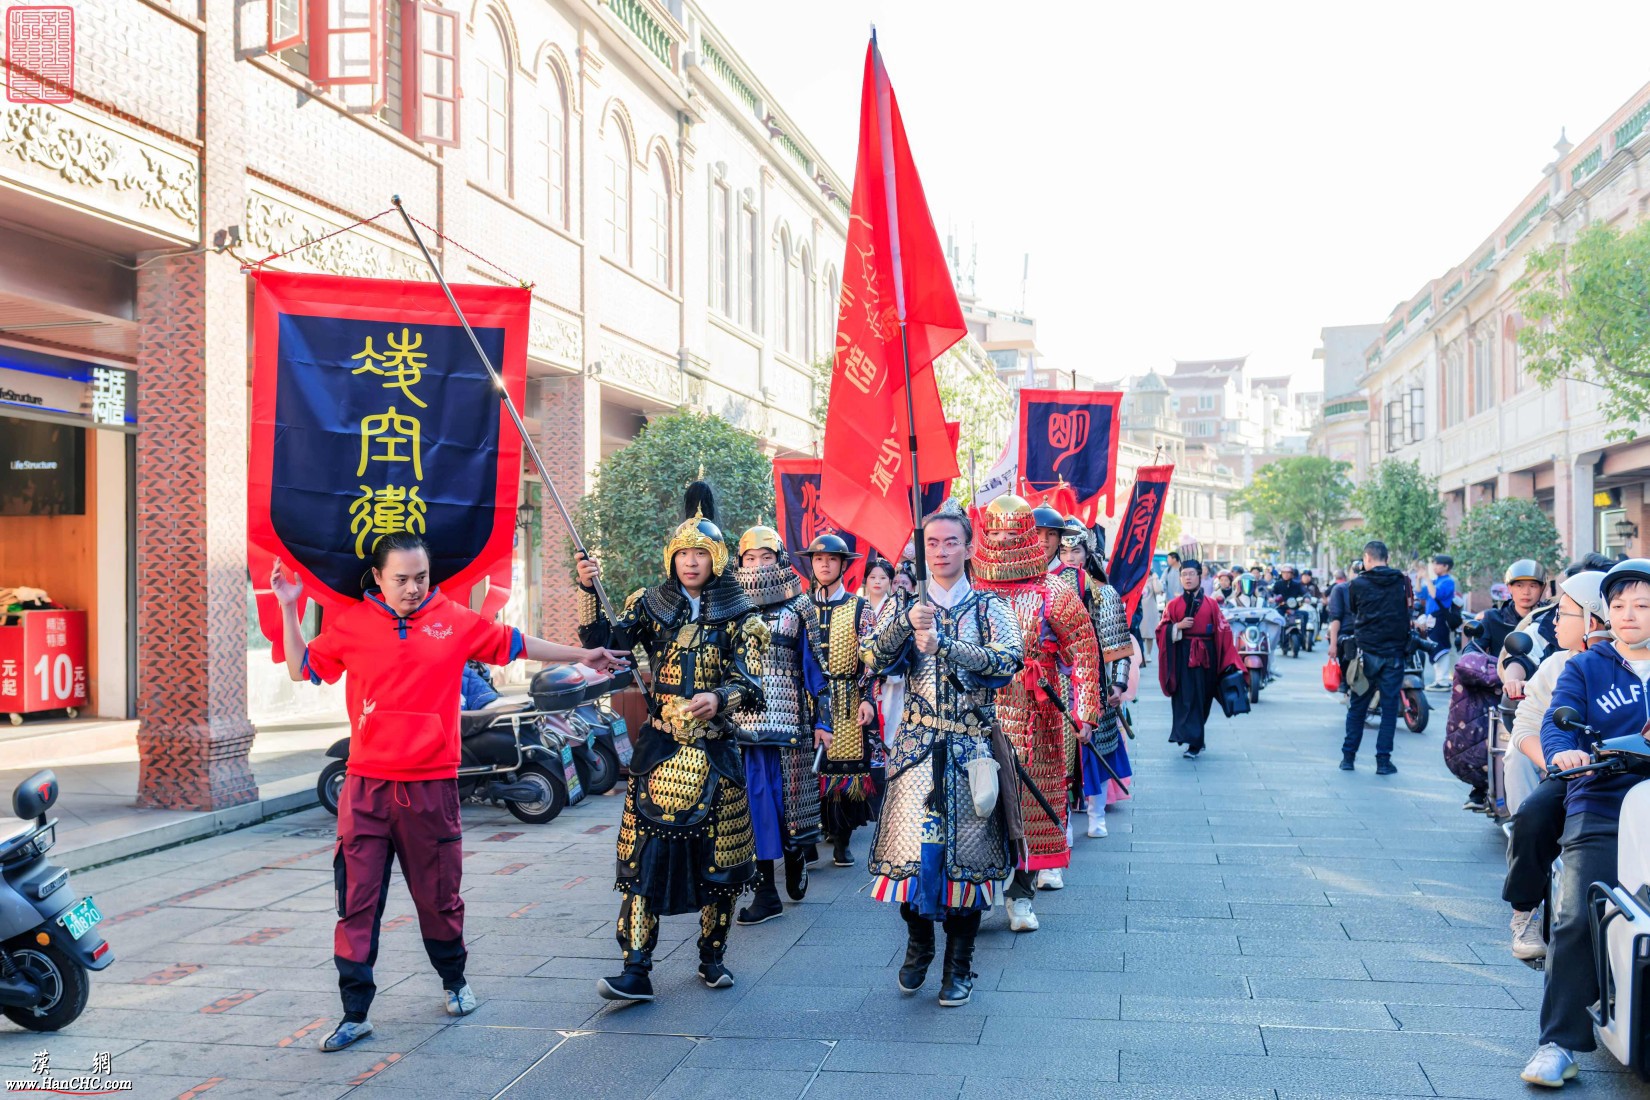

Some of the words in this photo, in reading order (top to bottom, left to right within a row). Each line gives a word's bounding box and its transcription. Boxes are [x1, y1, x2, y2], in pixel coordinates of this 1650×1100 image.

[92, 367, 126, 398] 生活
[10, 459, 58, 470] LifeStructure
[2, 659, 18, 696] 元起
[33, 653, 73, 701] 10
[74, 666, 86, 698] 元起
